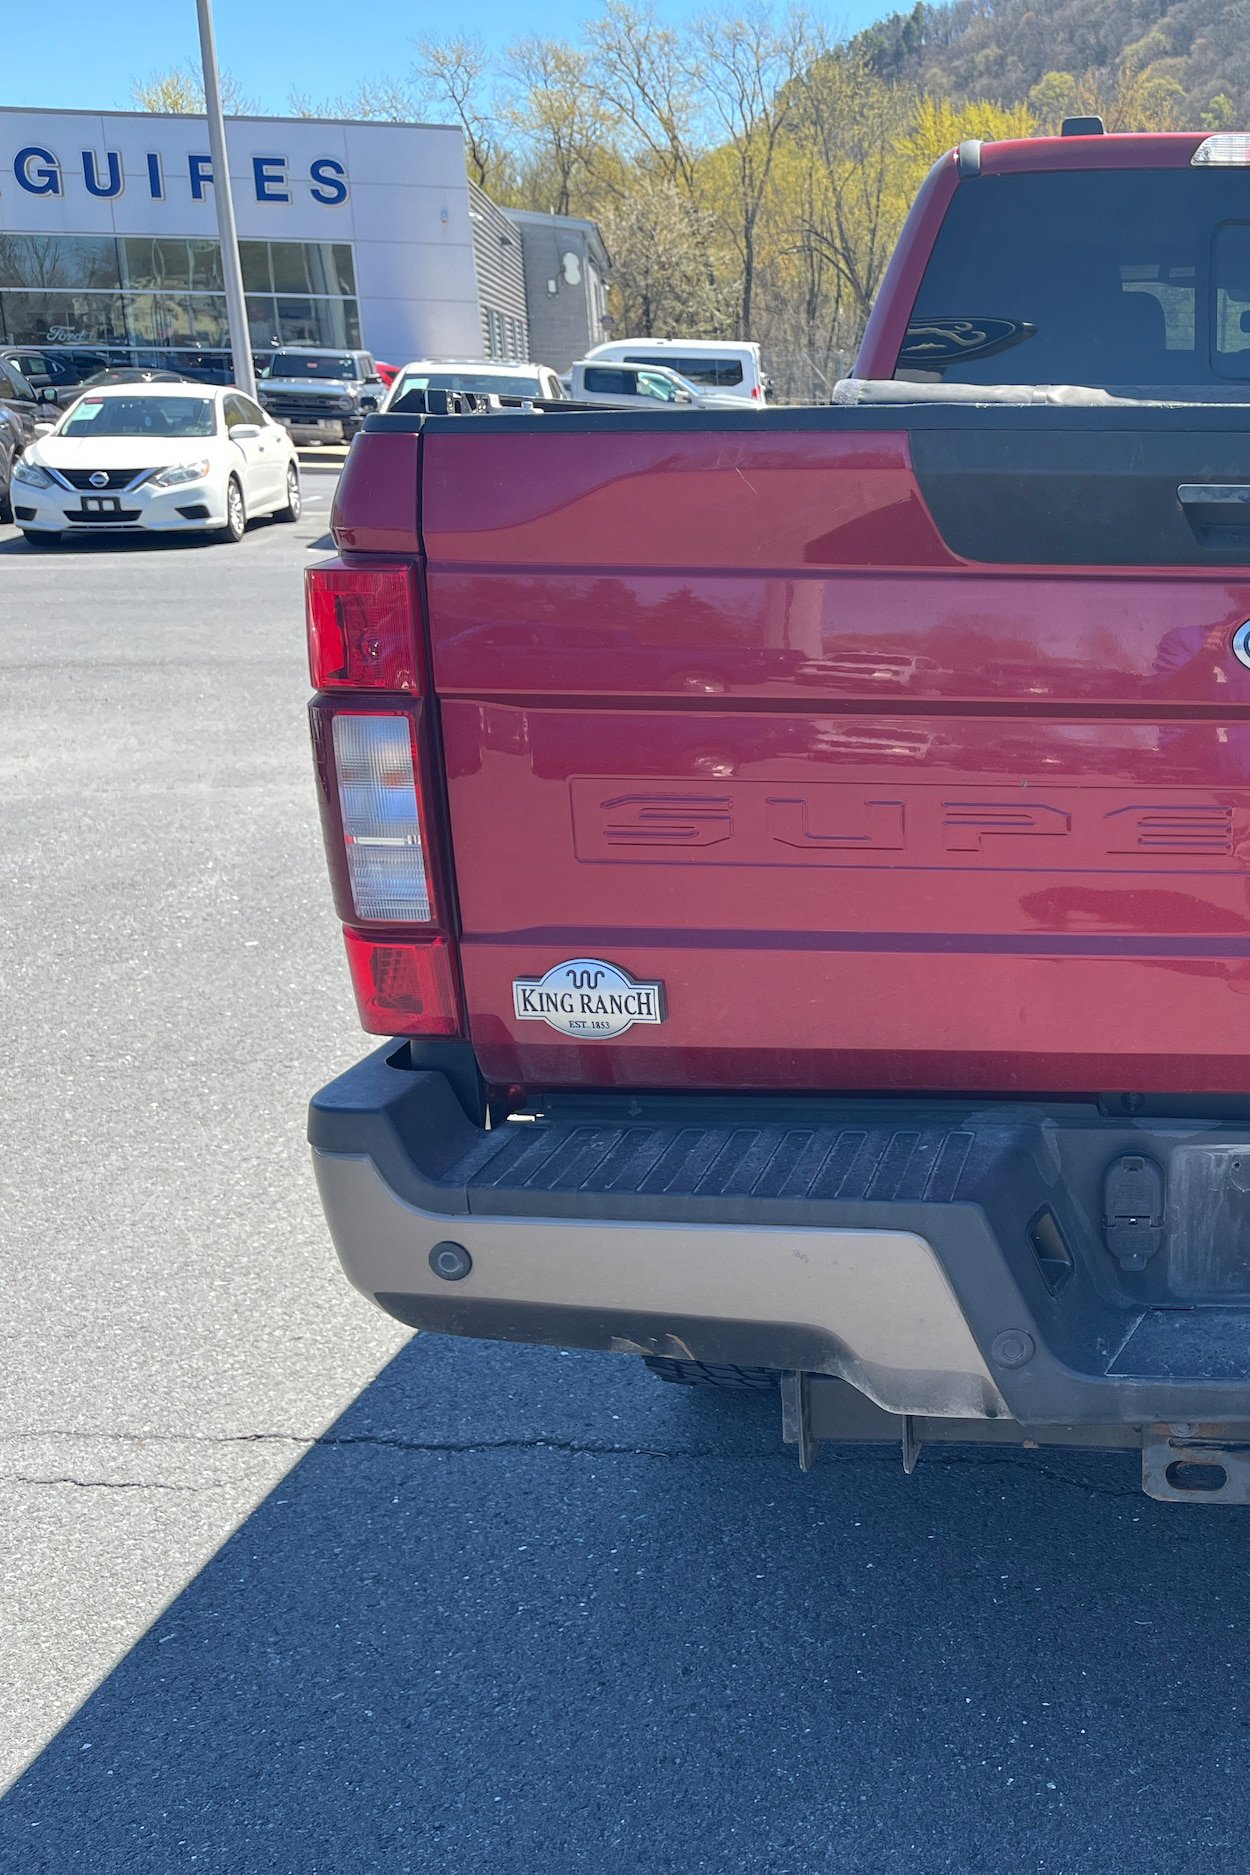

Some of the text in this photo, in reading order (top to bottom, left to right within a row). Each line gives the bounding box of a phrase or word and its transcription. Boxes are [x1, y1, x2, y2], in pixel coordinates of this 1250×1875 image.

[46, 324, 86, 341] Ford
[520, 988, 653, 1016] KING RANCH
[568, 1020, 610, 1030] EST. 1853
